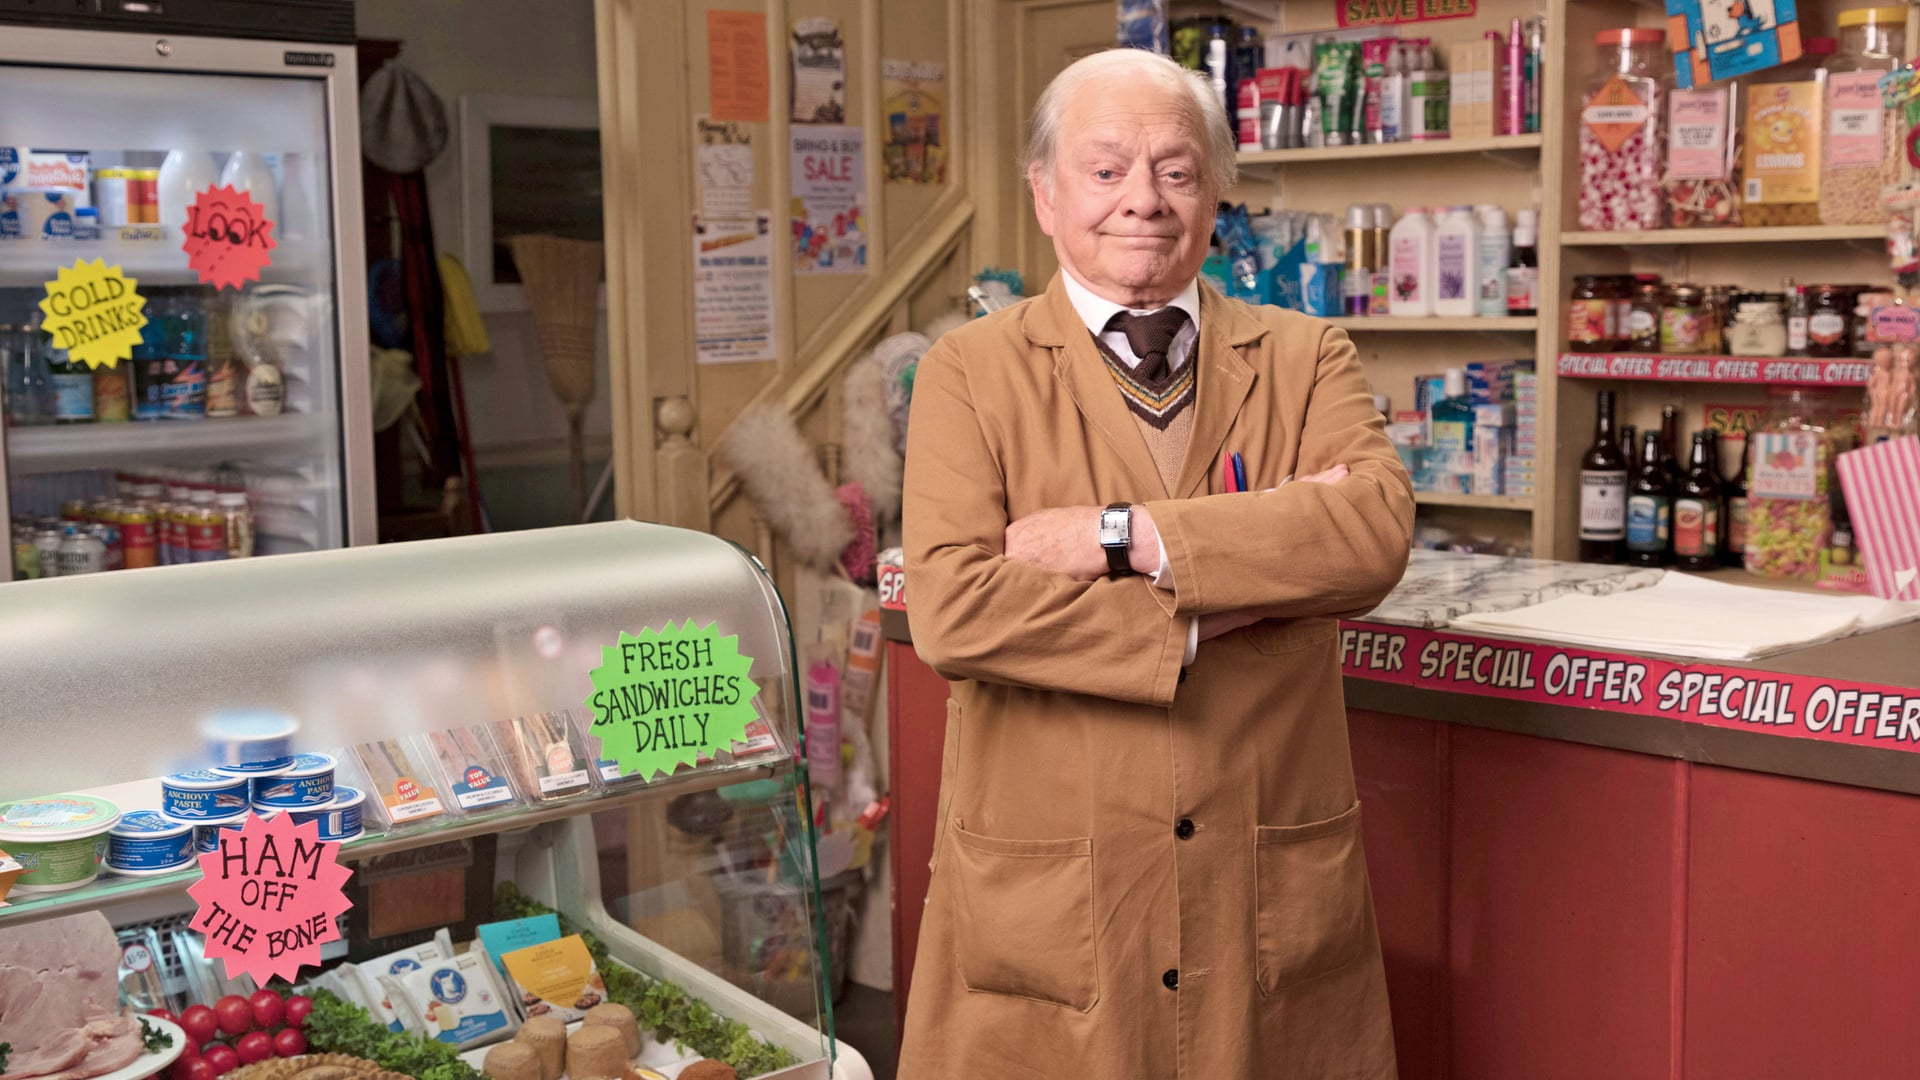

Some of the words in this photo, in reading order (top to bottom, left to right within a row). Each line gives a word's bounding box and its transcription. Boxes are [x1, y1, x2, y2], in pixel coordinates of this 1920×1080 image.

[1347, 0, 1418, 21] SAVE
[803, 155, 854, 181] SALE
[191, 206, 268, 248] LOOK
[49, 277, 125, 317] COLD
[57, 301, 140, 350] DRINKS
[1559, 355, 1608, 375] SPECIAL
[1609, 356, 1654, 376] OFFER
[1657, 358, 1711, 378] SPECIAL
[1714, 360, 1759, 380] OFFER
[1764, 361, 1821, 382] SPECIAL
[621, 638, 713, 674] FRESH
[593, 675, 741, 726] SANDWICHES
[1339, 629, 1408, 671] FFER
[1418, 639, 1536, 690] SPECIAL
[1543, 651, 1647, 705] OFFER
[1656, 668, 1795, 726] SPECIAL
[1803, 684, 1920, 744] OFFER
[633, 713, 710, 753] DAILY
[307, 784, 330, 795] PASTE
[399, 782, 413, 792] TOP
[467, 776, 492, 789] VALUE
[469, 770, 484, 780] TOP
[168, 790, 211, 801] ANCHOVY
[173, 799, 202, 808] PASTE
[399, 789, 421, 801] VALUE
[220, 834, 326, 881] HAM
[241, 879, 298, 912] OFF
[202, 901, 257, 955] THE
[266, 911, 328, 960] BONE
